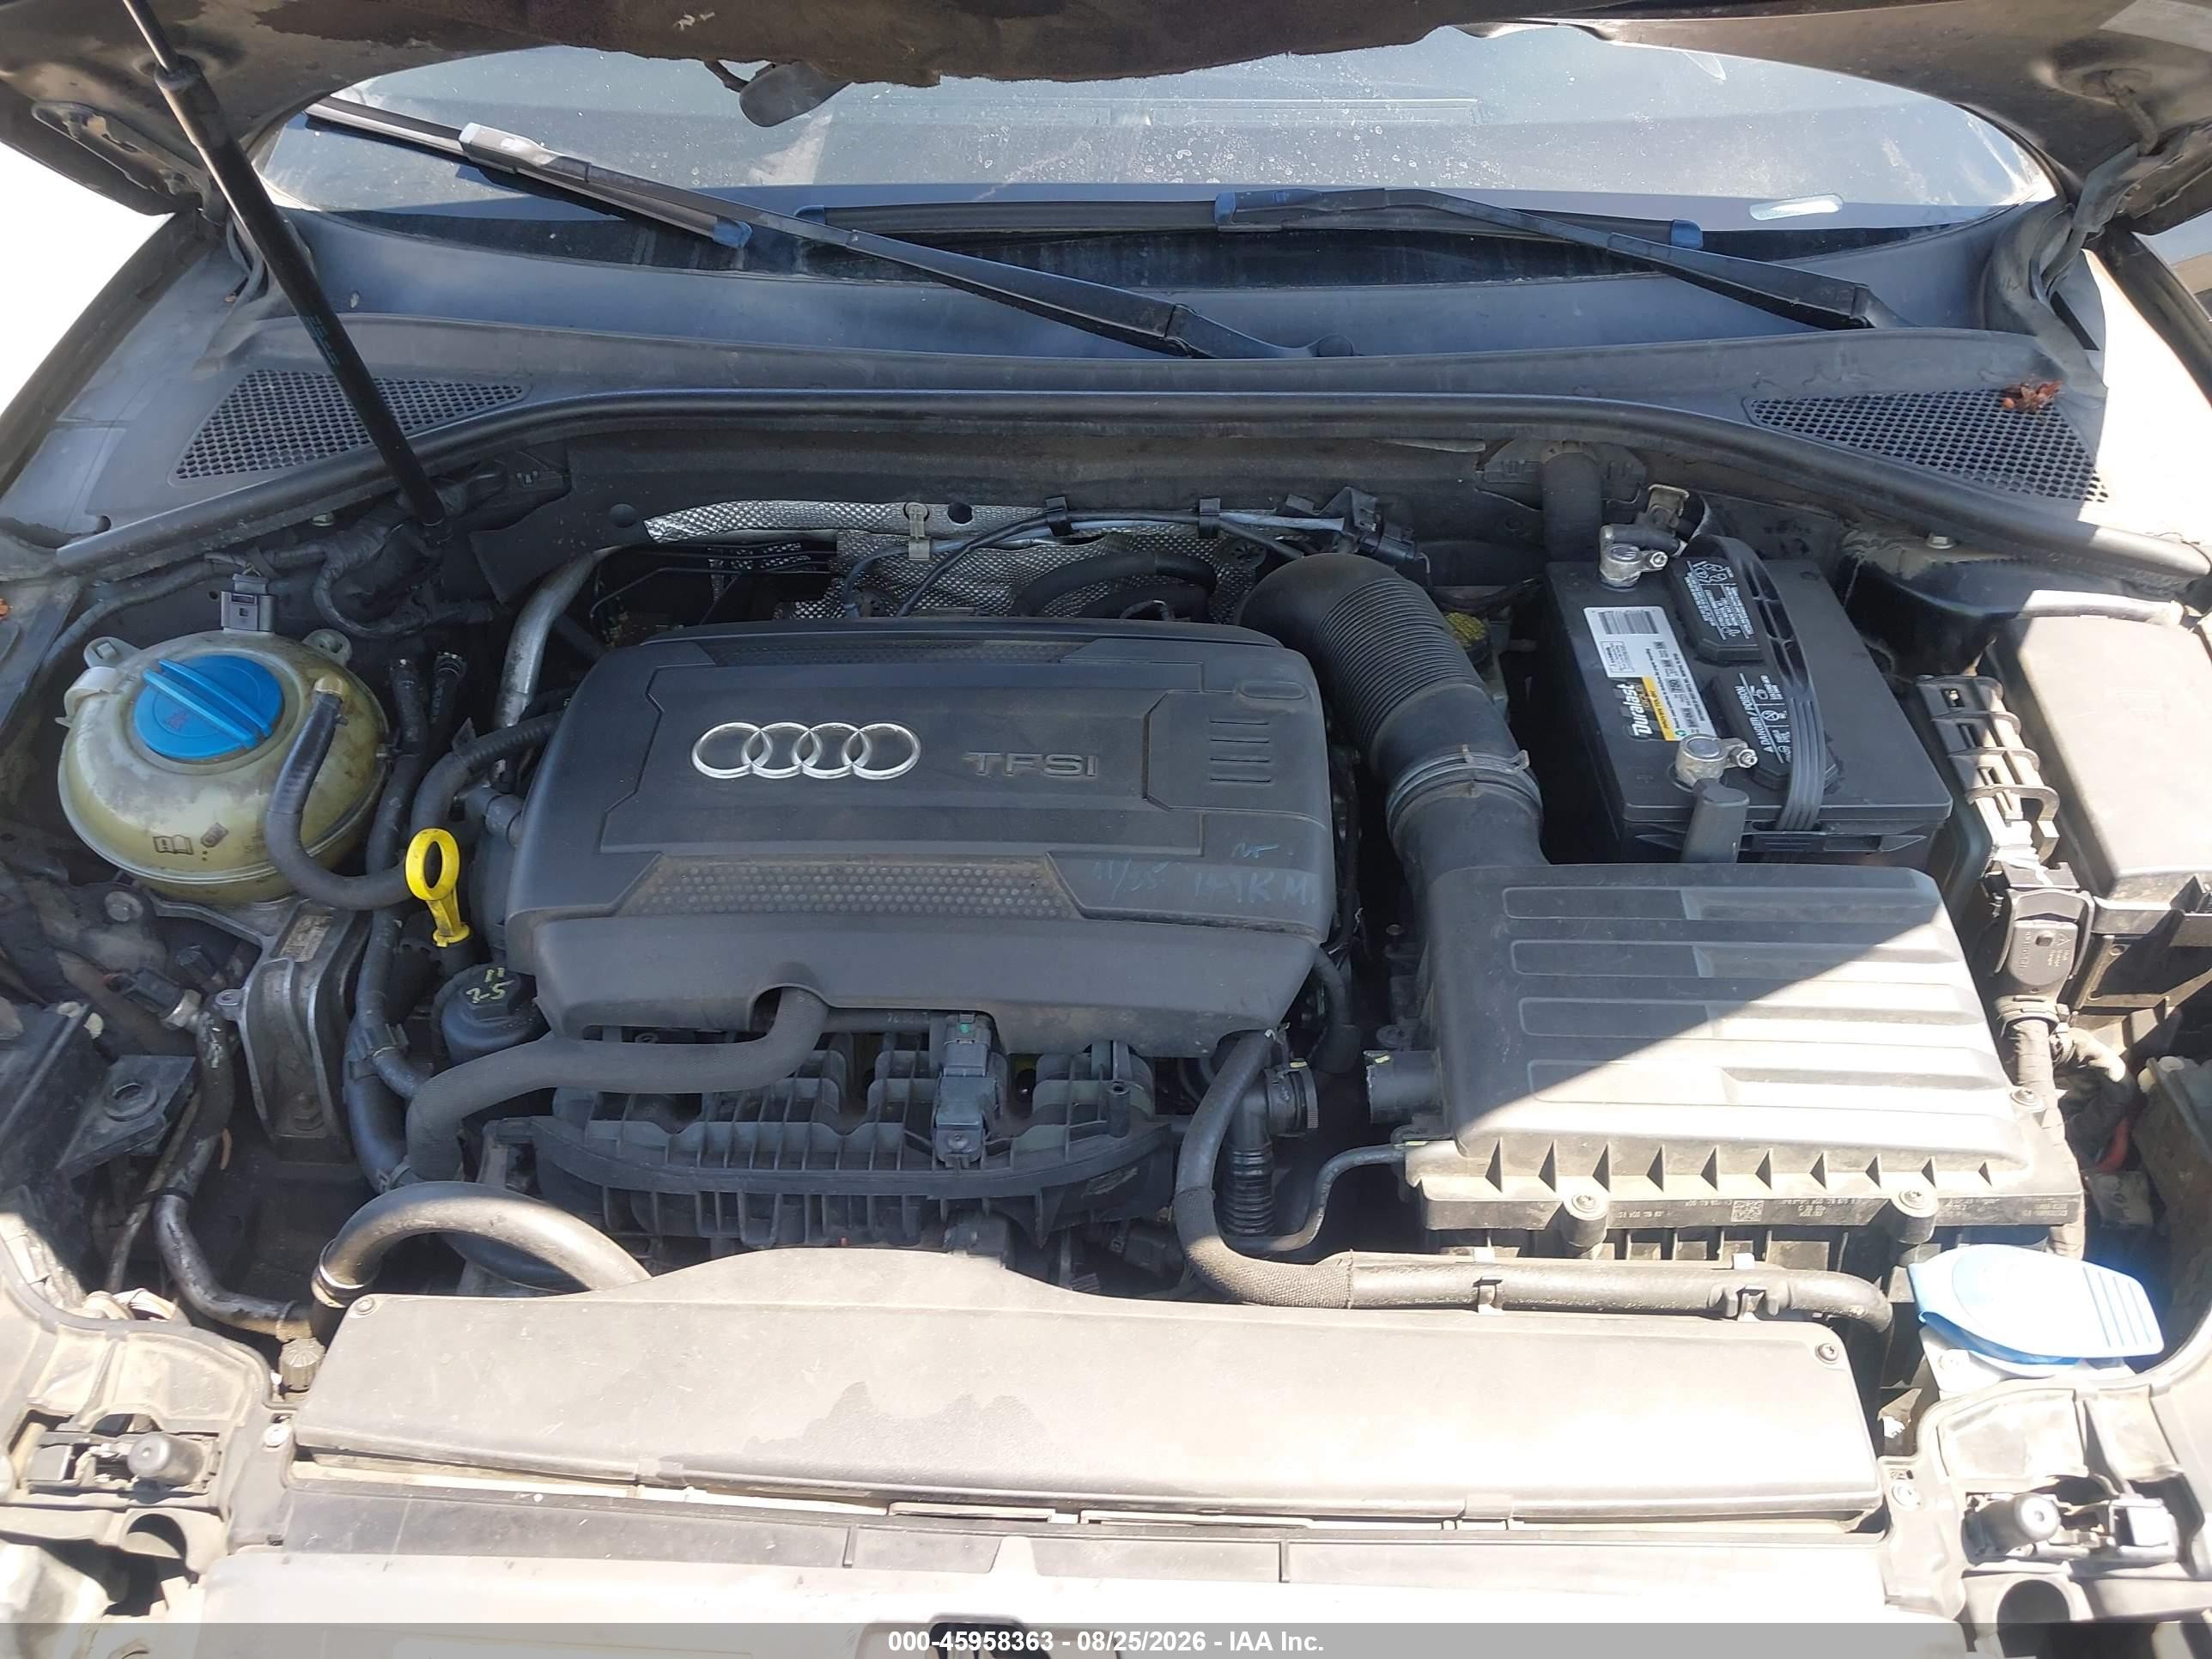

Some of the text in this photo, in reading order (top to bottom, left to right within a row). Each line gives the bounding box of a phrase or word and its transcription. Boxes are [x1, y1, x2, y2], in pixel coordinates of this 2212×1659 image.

[1617, 684, 1653, 736] Duralast
[1735, 685, 1756, 710] POISON
[1748, 716, 1772, 745] DANGER
[966, 750, 1098, 778] TFSI
